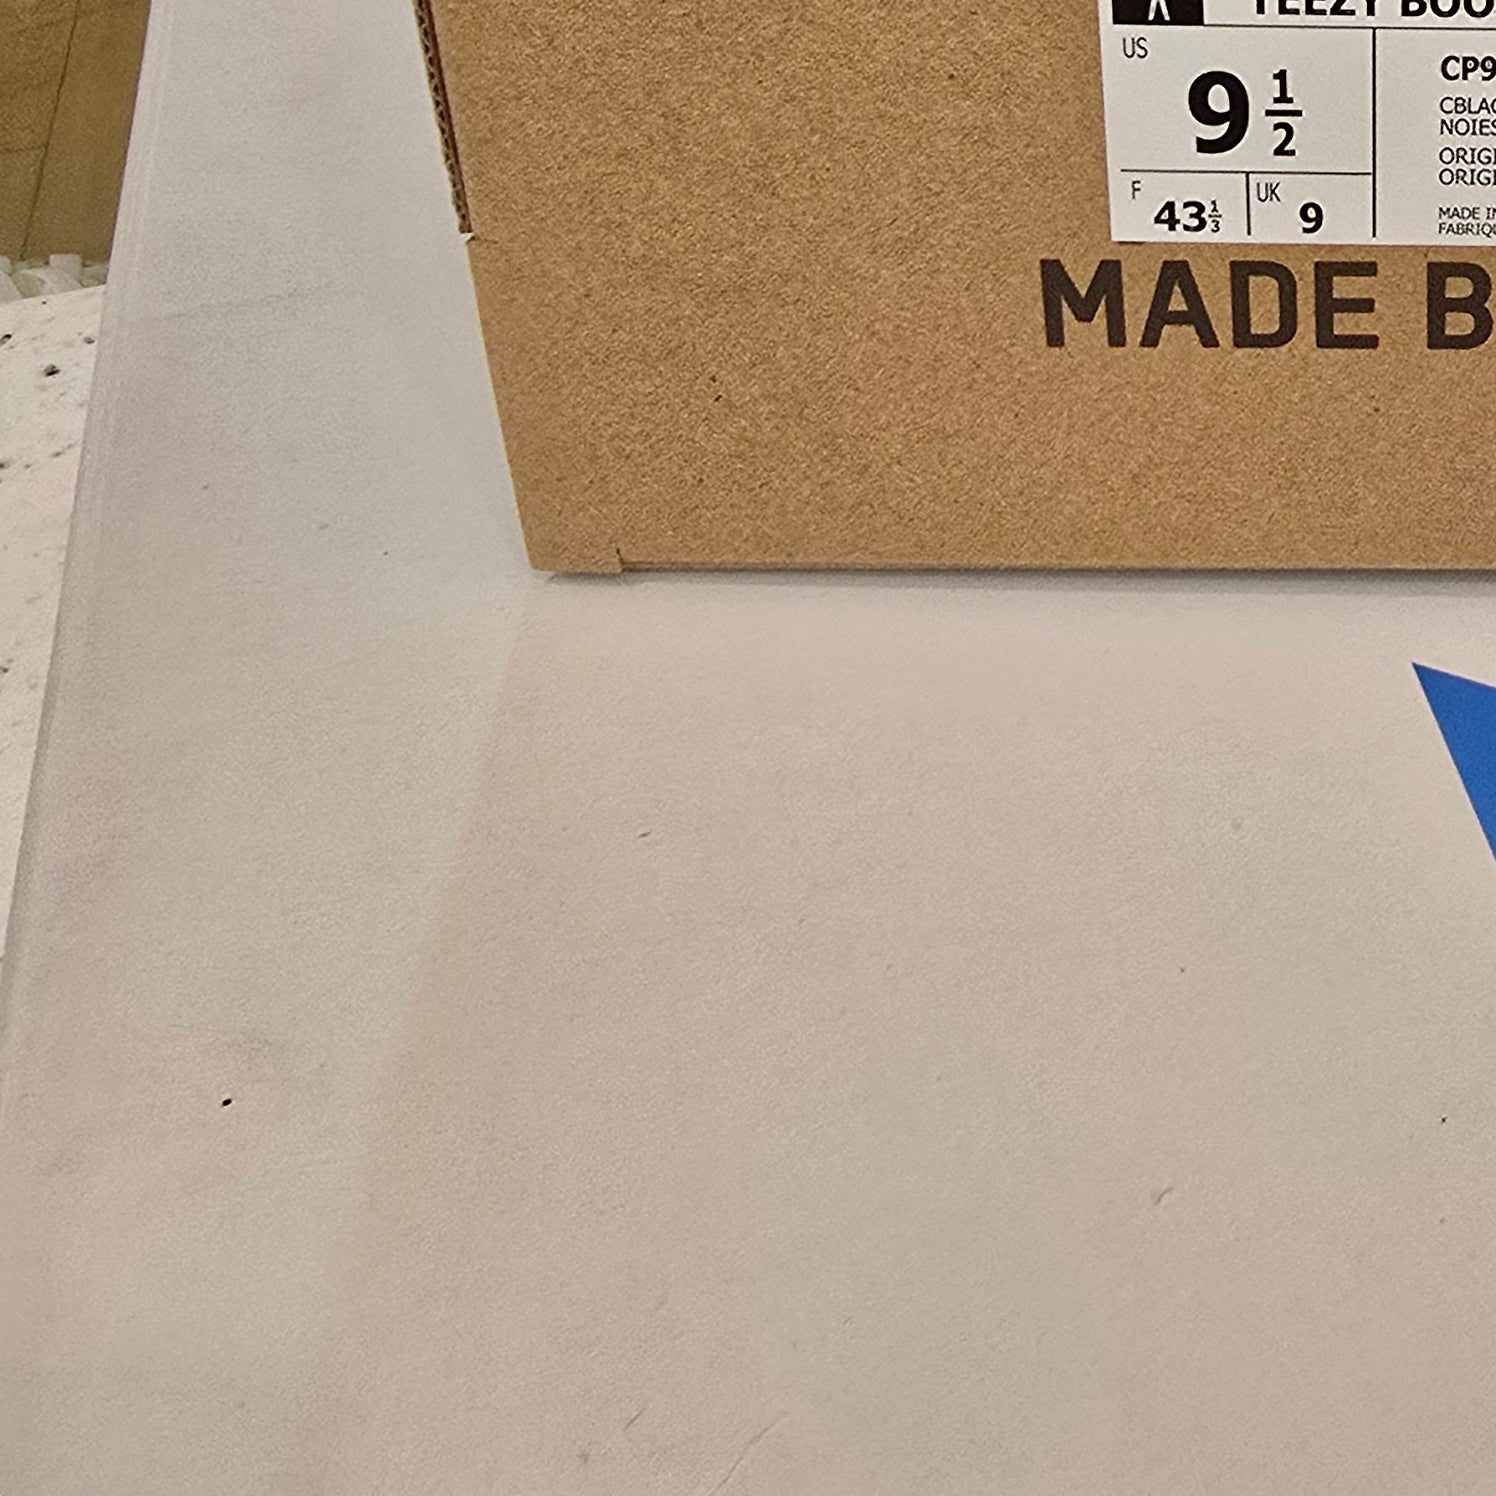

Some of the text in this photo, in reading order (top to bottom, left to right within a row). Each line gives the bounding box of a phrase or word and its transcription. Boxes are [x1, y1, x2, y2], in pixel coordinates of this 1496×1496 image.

[1122, 37, 1149, 59] US
[1188, 70, 1250, 154] 9
[1131, 180, 1142, 200] F
[1256, 182, 1281, 203] UK
[1299, 202, 1323, 234] 9
[1438, 207, 1481, 221] MADE
[1039, 258, 1381, 350] MADE
